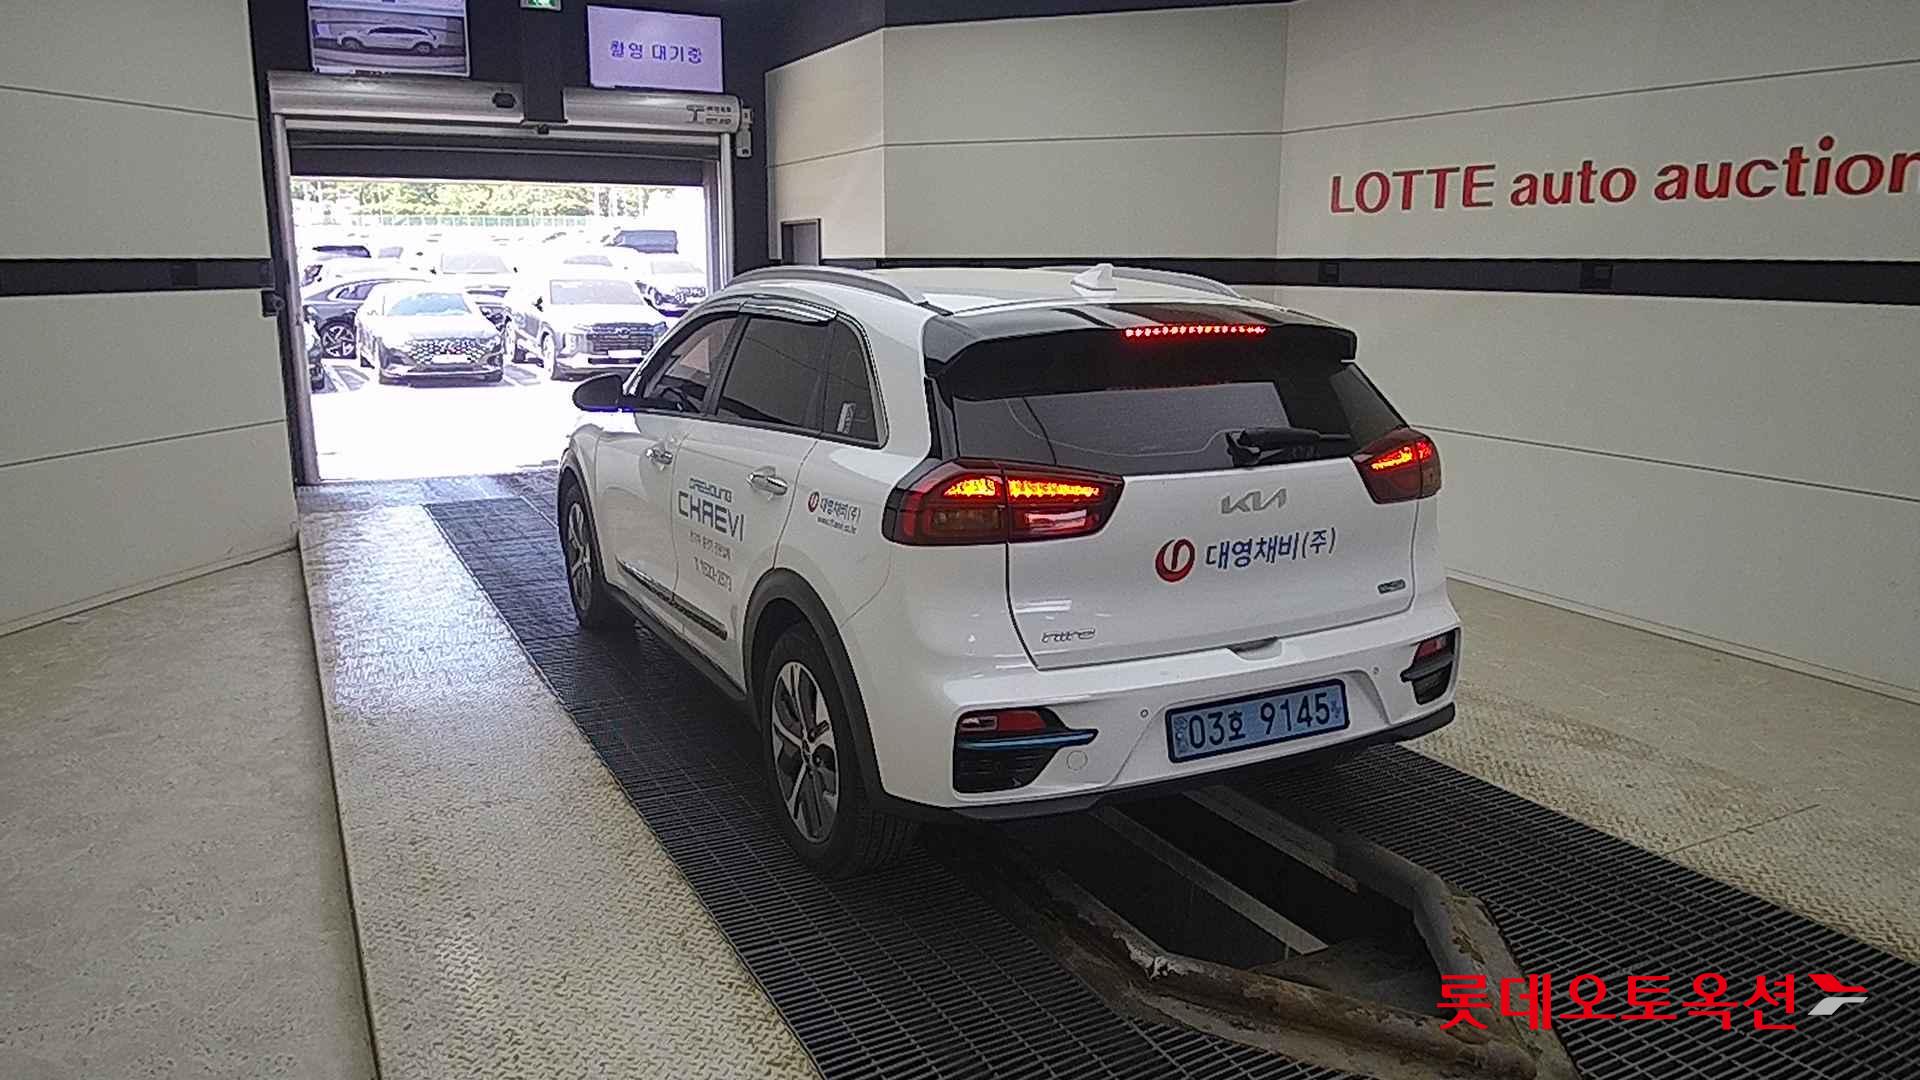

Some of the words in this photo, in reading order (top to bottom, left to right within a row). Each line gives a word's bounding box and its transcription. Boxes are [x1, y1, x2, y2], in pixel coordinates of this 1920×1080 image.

[651, 43, 702, 64] 대기중
[1331, 164, 1496, 213] LOTTE
[1511, 160, 1637, 205] auto
[678, 490, 744, 542] CHAEVI
[1205, 527, 1336, 570] 대영채비(주)
[1188, 710, 1246, 750] 03호
[1260, 692, 1330, 736] 9145
